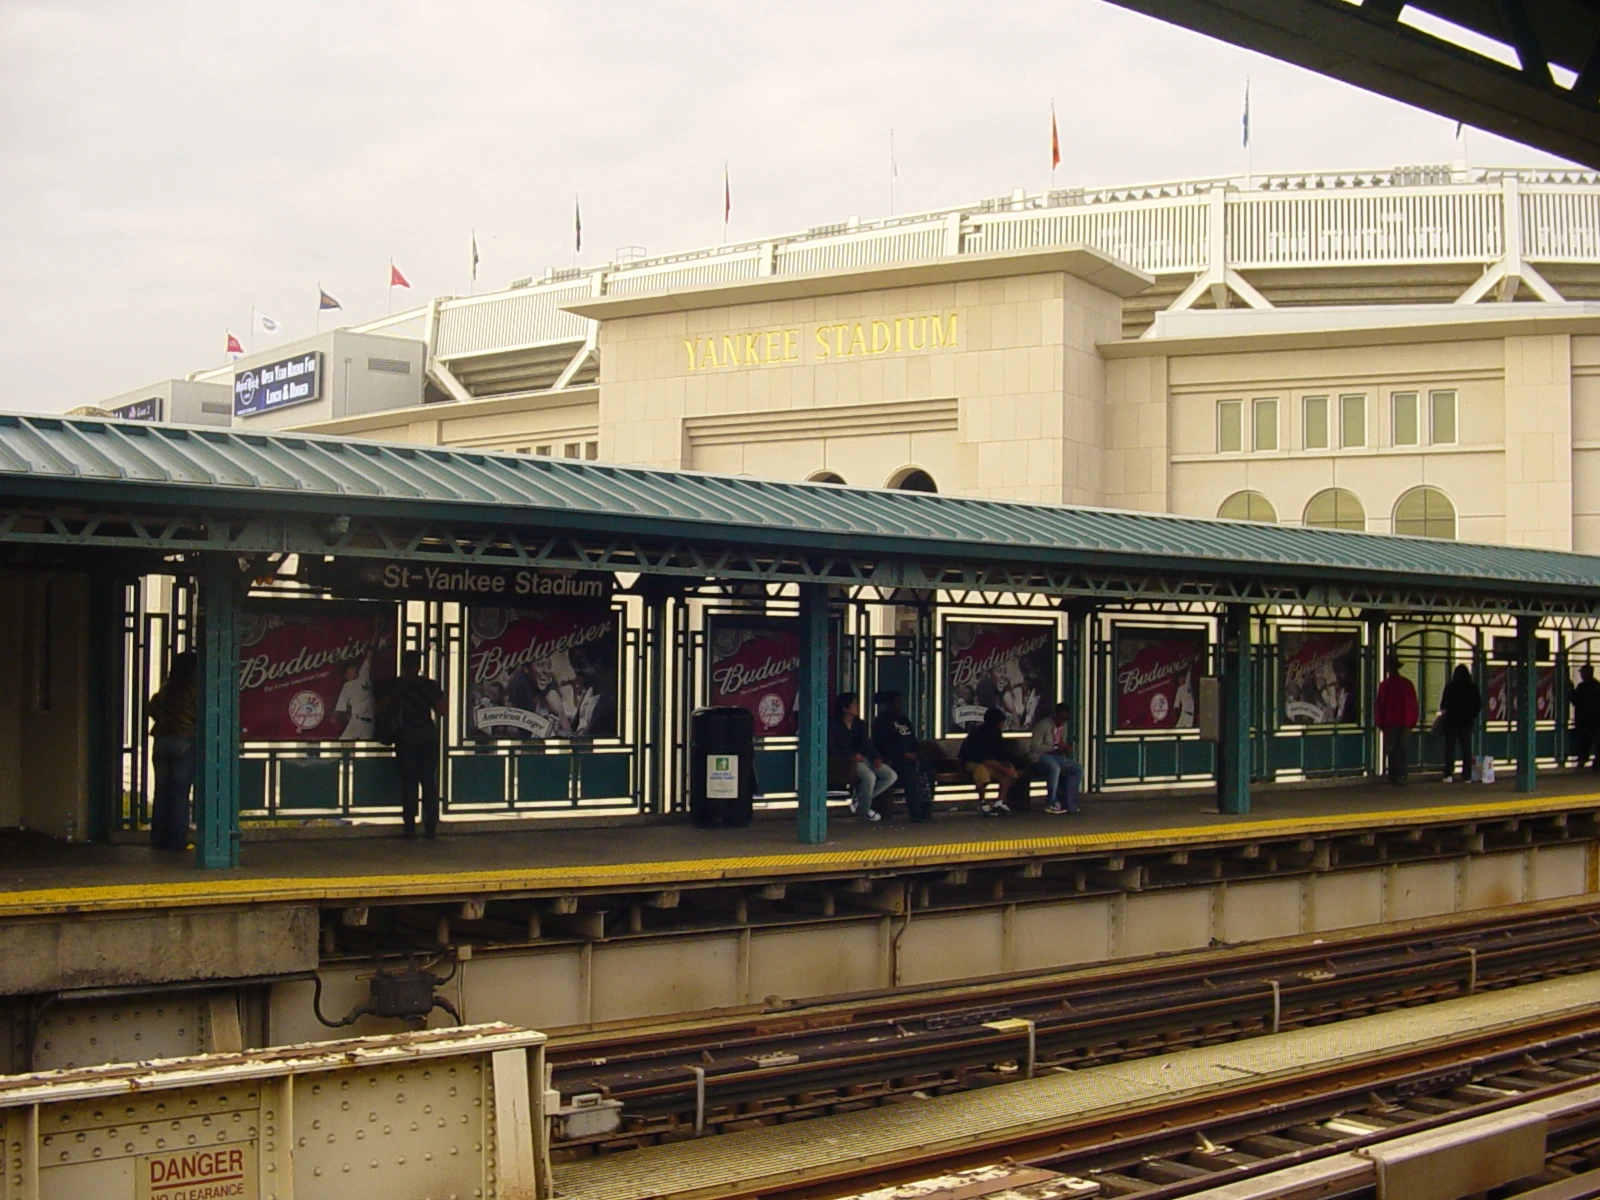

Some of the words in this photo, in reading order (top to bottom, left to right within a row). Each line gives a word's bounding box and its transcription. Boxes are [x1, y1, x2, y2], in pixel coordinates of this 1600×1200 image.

[683, 329, 799, 371] YANKEE
[815, 313, 959, 359] STADIUM
[383, 565, 506, 594] St-Yankee
[515, 571, 604, 598] Stadium
[470, 620, 612, 684] Budweiser
[950, 633, 1049, 687] Budweiser
[150, 1150, 244, 1184] DANGER
[174, 1183, 245, 1200] CLEARANCE
